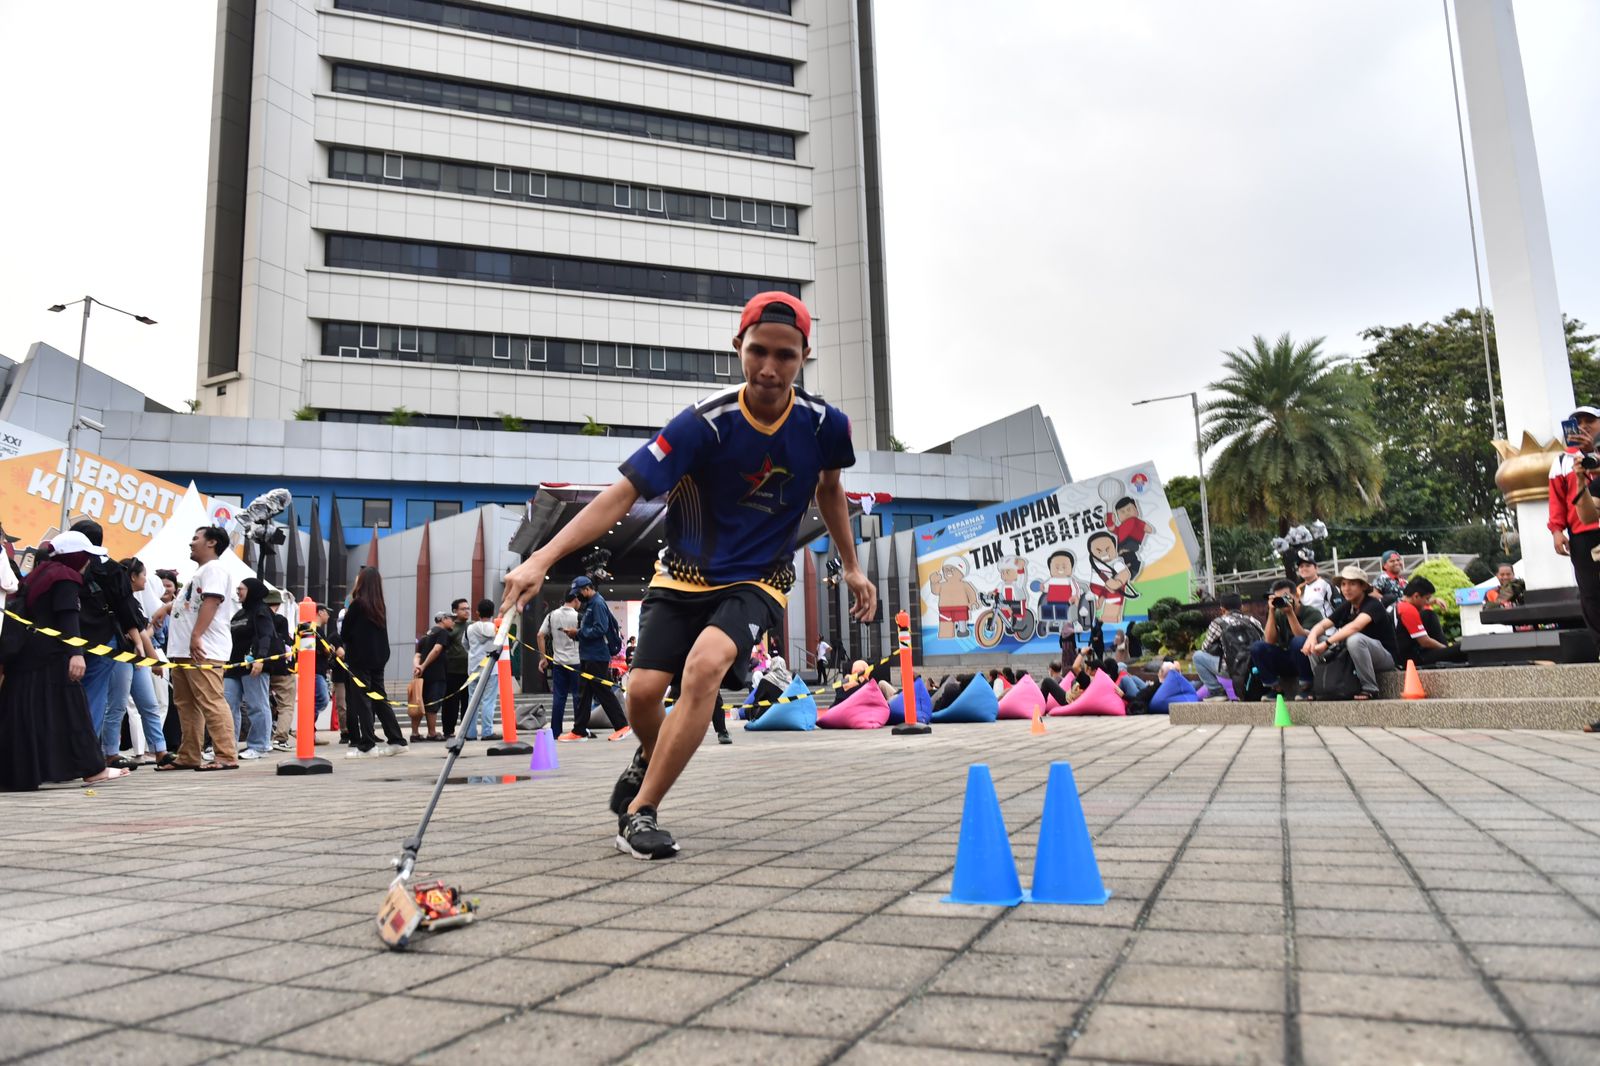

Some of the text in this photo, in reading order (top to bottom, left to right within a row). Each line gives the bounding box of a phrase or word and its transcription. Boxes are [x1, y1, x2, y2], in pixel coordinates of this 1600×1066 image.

[3, 433, 22, 447] XXI
[28, 467, 165, 539] KITA JUA
[995, 493, 1061, 535] IMPIAN
[969, 505, 1106, 570] TAK TERBATAS
